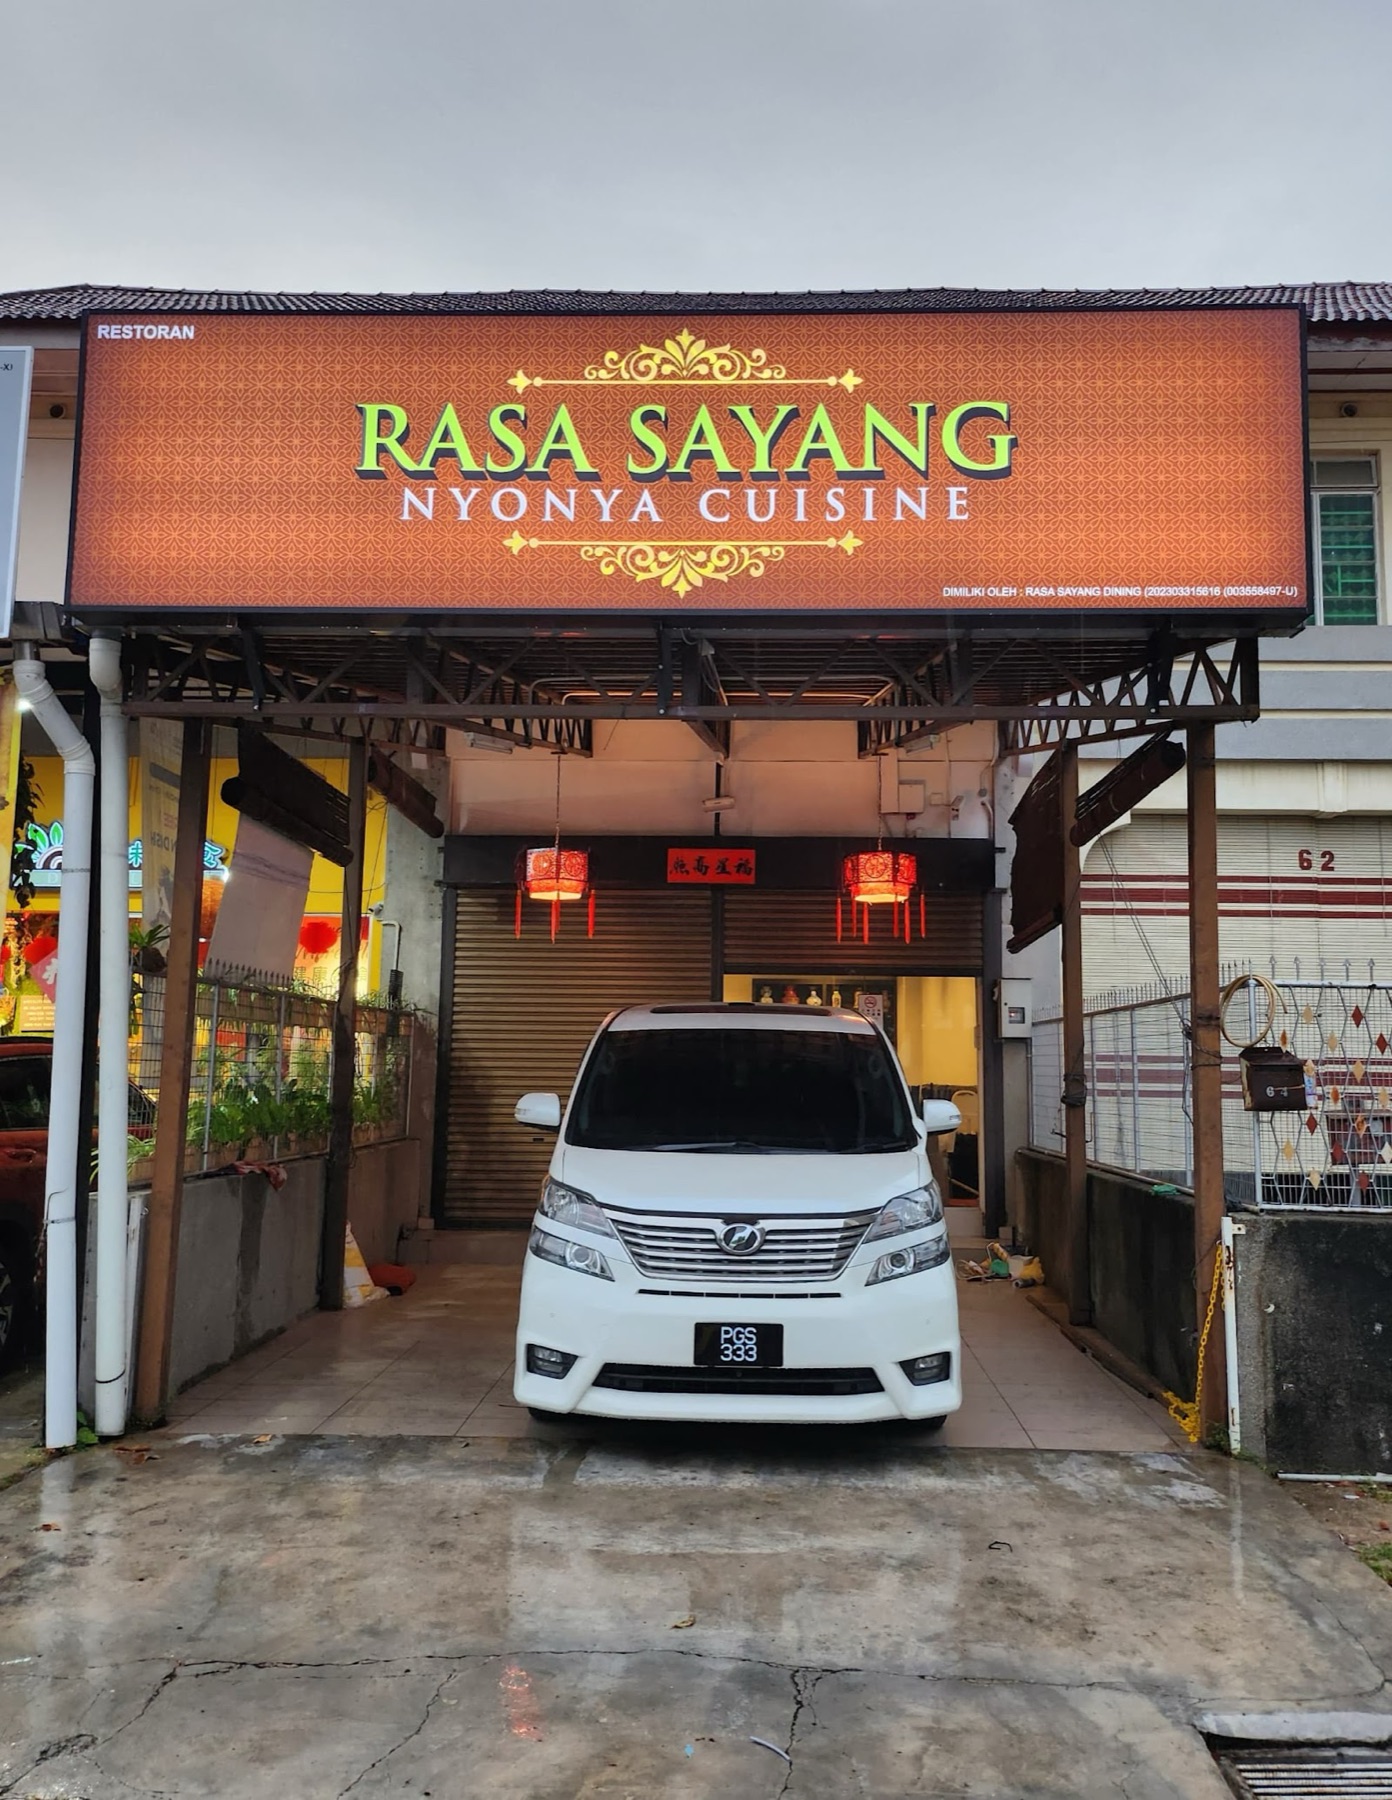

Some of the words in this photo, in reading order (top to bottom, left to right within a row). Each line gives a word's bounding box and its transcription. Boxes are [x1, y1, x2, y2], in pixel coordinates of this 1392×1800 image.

[97, 324, 195, 340] RESTORAN
[355, 401, 601, 481] RASA
[627, 401, 1018, 482] SAYANG
[400, 486, 663, 522] NYONYA
[699, 486, 970, 523] CUISINE
[943, 587, 985, 597] DIMILIKI
[987, 587, 1017, 597] OLEH
[1025, 587, 1055, 597] RASA
[1057, 587, 1101, 597] SAYANG
[1103, 587, 1141, 597] DINING
[1298, 849, 1335, 872] 62
[721, 1326, 757, 1344] PGS
[720, 1343, 757, 1362] 333
